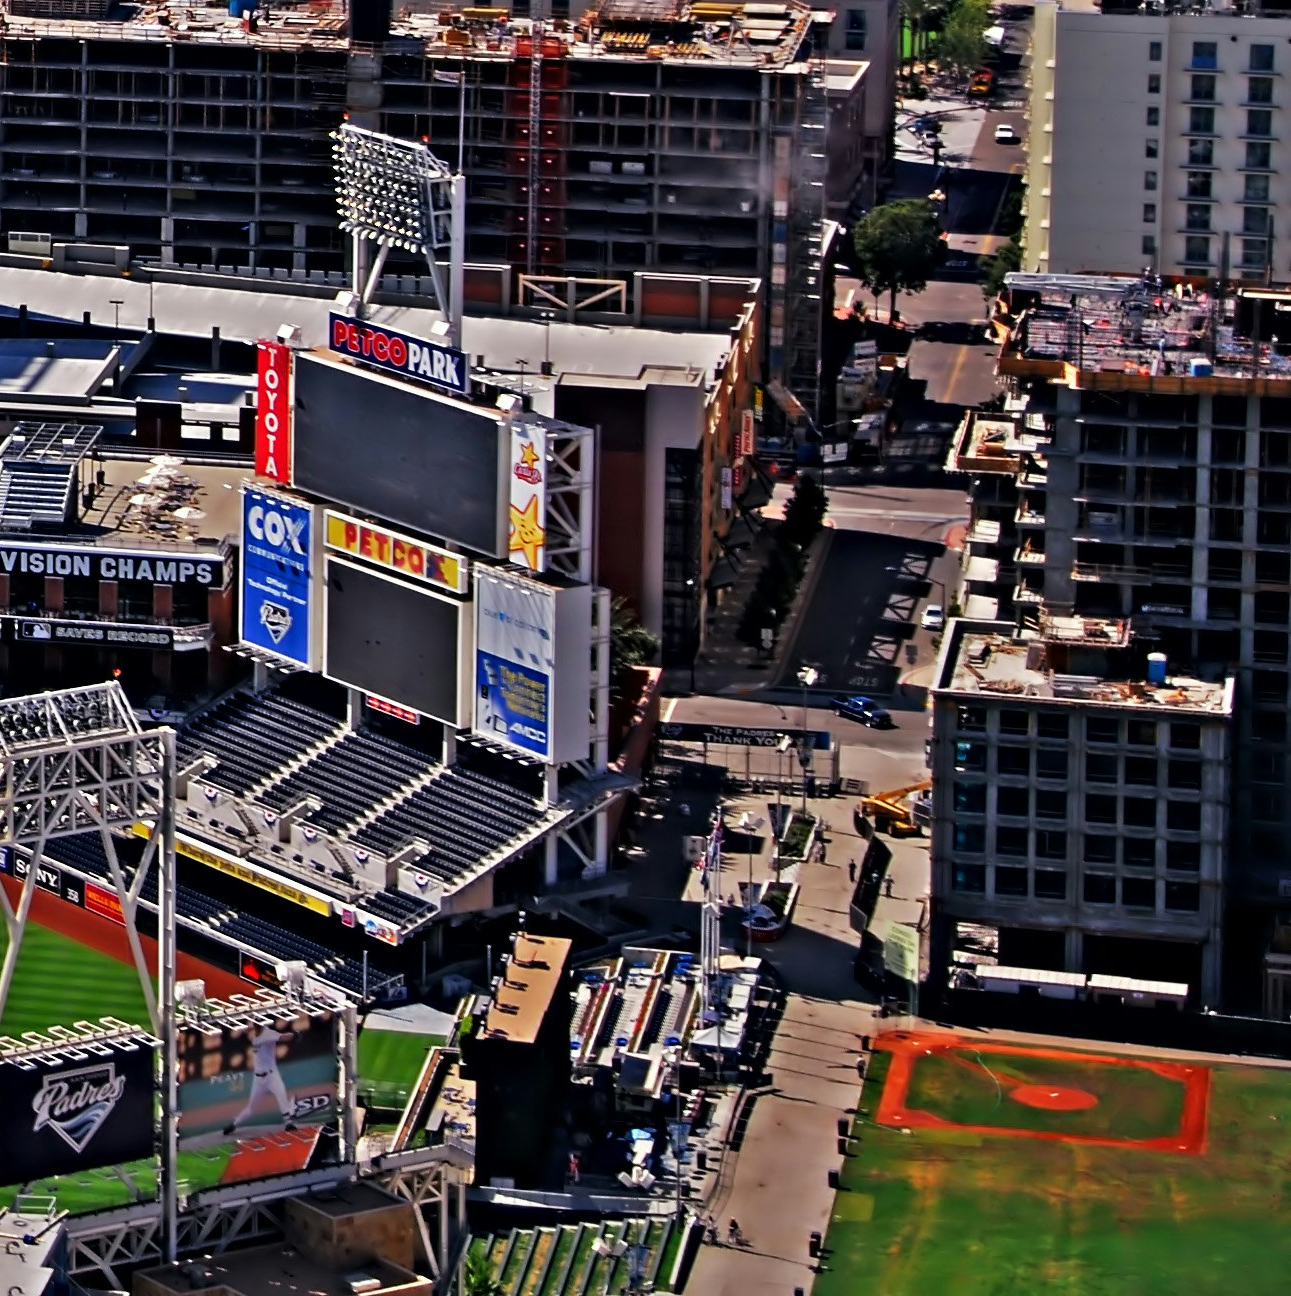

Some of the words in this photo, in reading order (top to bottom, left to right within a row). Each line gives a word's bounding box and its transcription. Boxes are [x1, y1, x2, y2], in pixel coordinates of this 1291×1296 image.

[333, 320, 407, 366] PETCO
[408, 342, 460, 386] PARK
[265, 347, 279, 477] TOYOTA
[248, 505, 307, 555] COX
[345, 522, 424, 573] PETCO
[100, 557, 213, 584] CHAMPS
[704, 733, 751, 745] THANK
[33, 1074, 126, 1132] Padres
